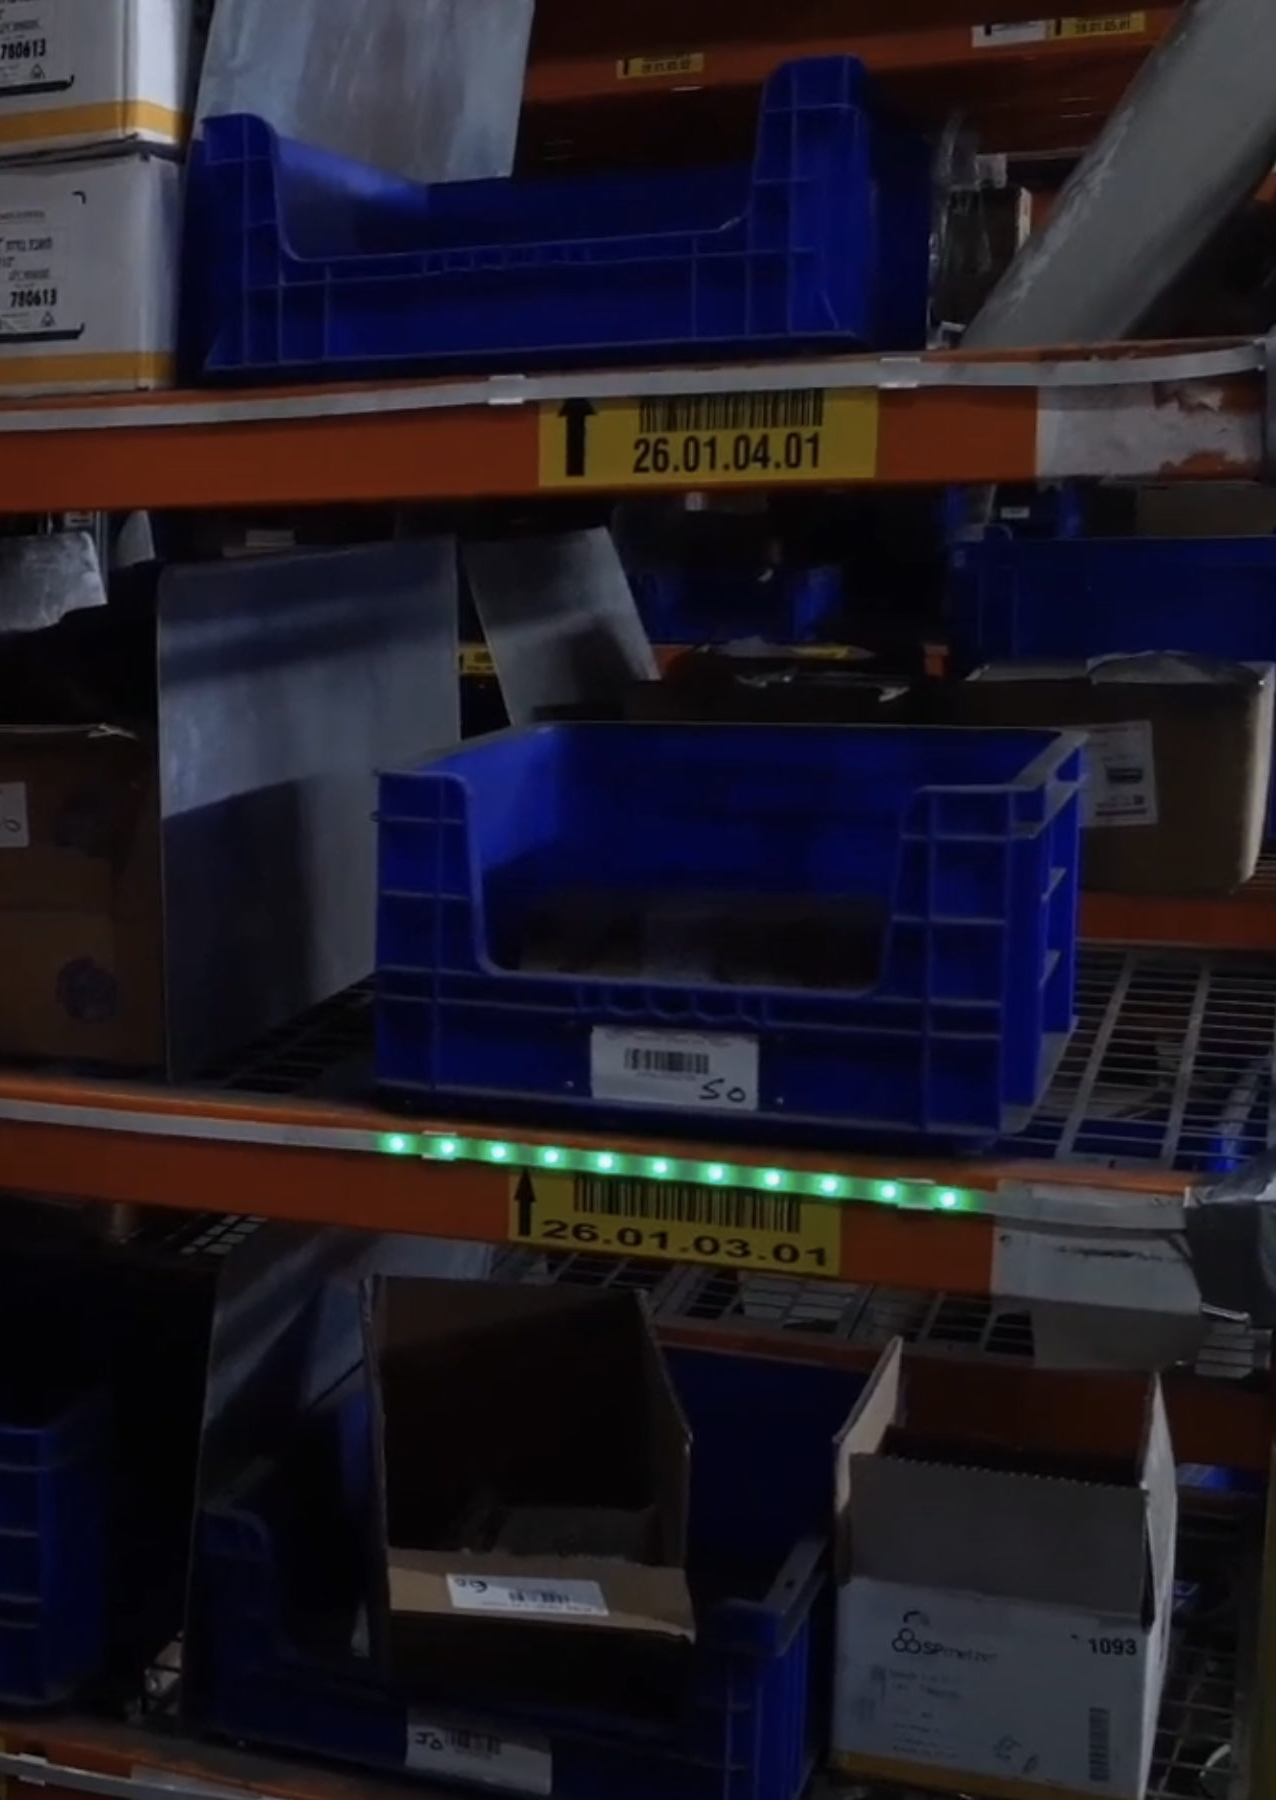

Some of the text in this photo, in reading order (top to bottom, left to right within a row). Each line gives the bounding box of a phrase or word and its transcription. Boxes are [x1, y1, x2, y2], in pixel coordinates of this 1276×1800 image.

[0, 38, 47, 60] 780613
[10, 289, 58, 308] 780613
[633, 432, 822, 476] 26.01.04.01
[541, 1218, 829, 1267] 26.01.03.01
[1086, 1637, 1137, 1657] 1093
